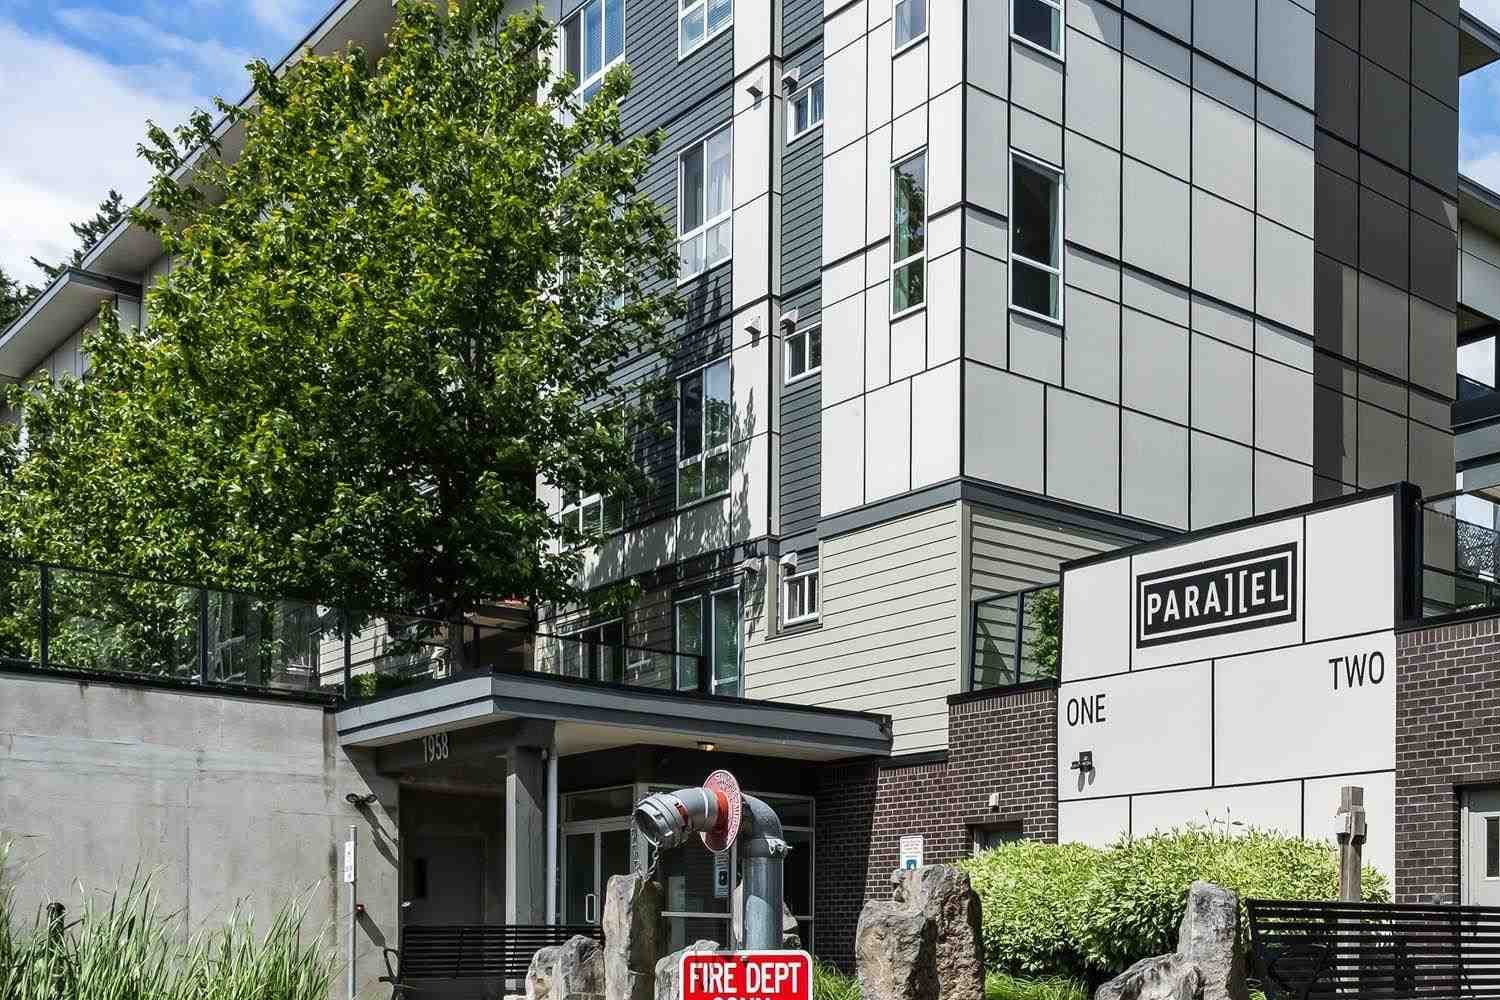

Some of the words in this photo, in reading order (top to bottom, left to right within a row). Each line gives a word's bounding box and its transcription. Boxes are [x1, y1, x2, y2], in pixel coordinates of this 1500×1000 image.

[1328, 651, 1385, 690] TWO
[1066, 694, 1106, 727] ONE
[422, 733, 449, 764] 1958
[689, 962, 738, 994] FIRE
[746, 962, 802, 994] DEPT
